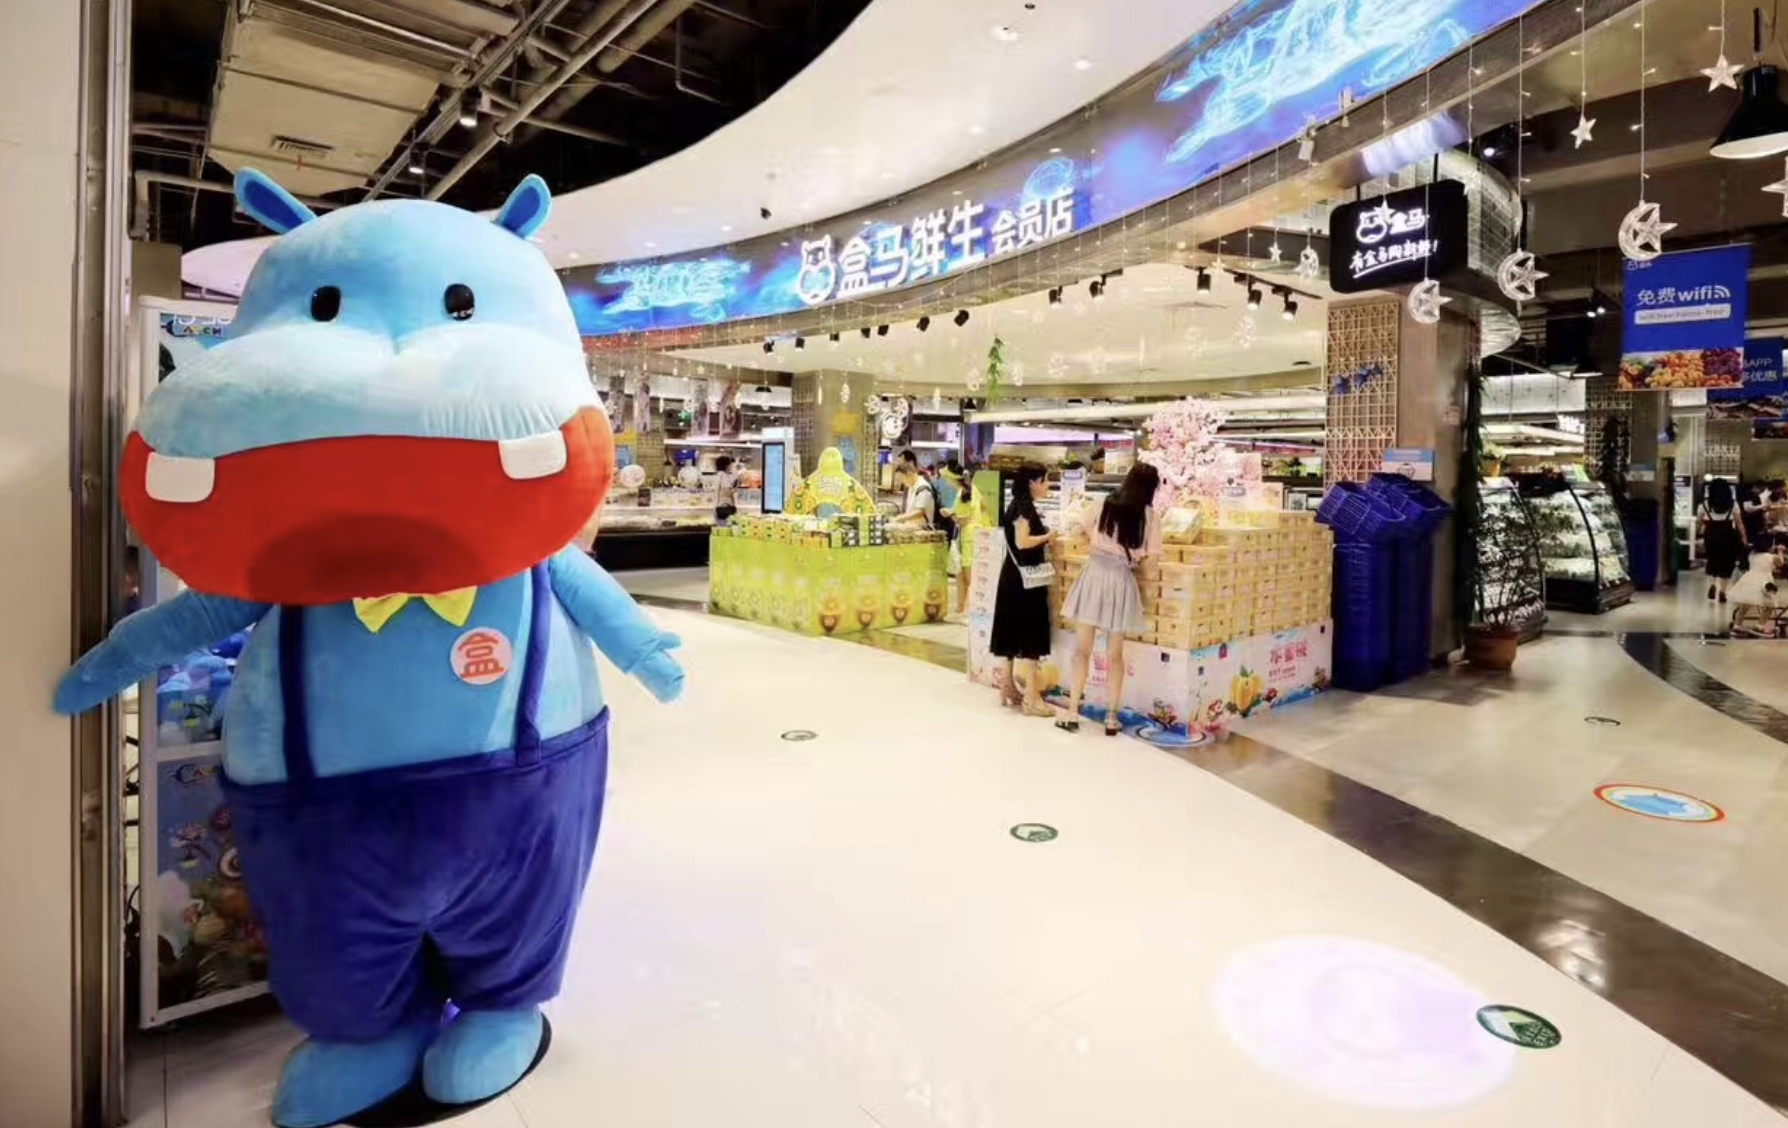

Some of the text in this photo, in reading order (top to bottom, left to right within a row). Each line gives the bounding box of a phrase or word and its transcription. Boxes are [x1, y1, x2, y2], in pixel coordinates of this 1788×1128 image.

[839, 188, 1073, 293] 盒马鲜生 会员店
[457, 631, 505, 678] 盒
